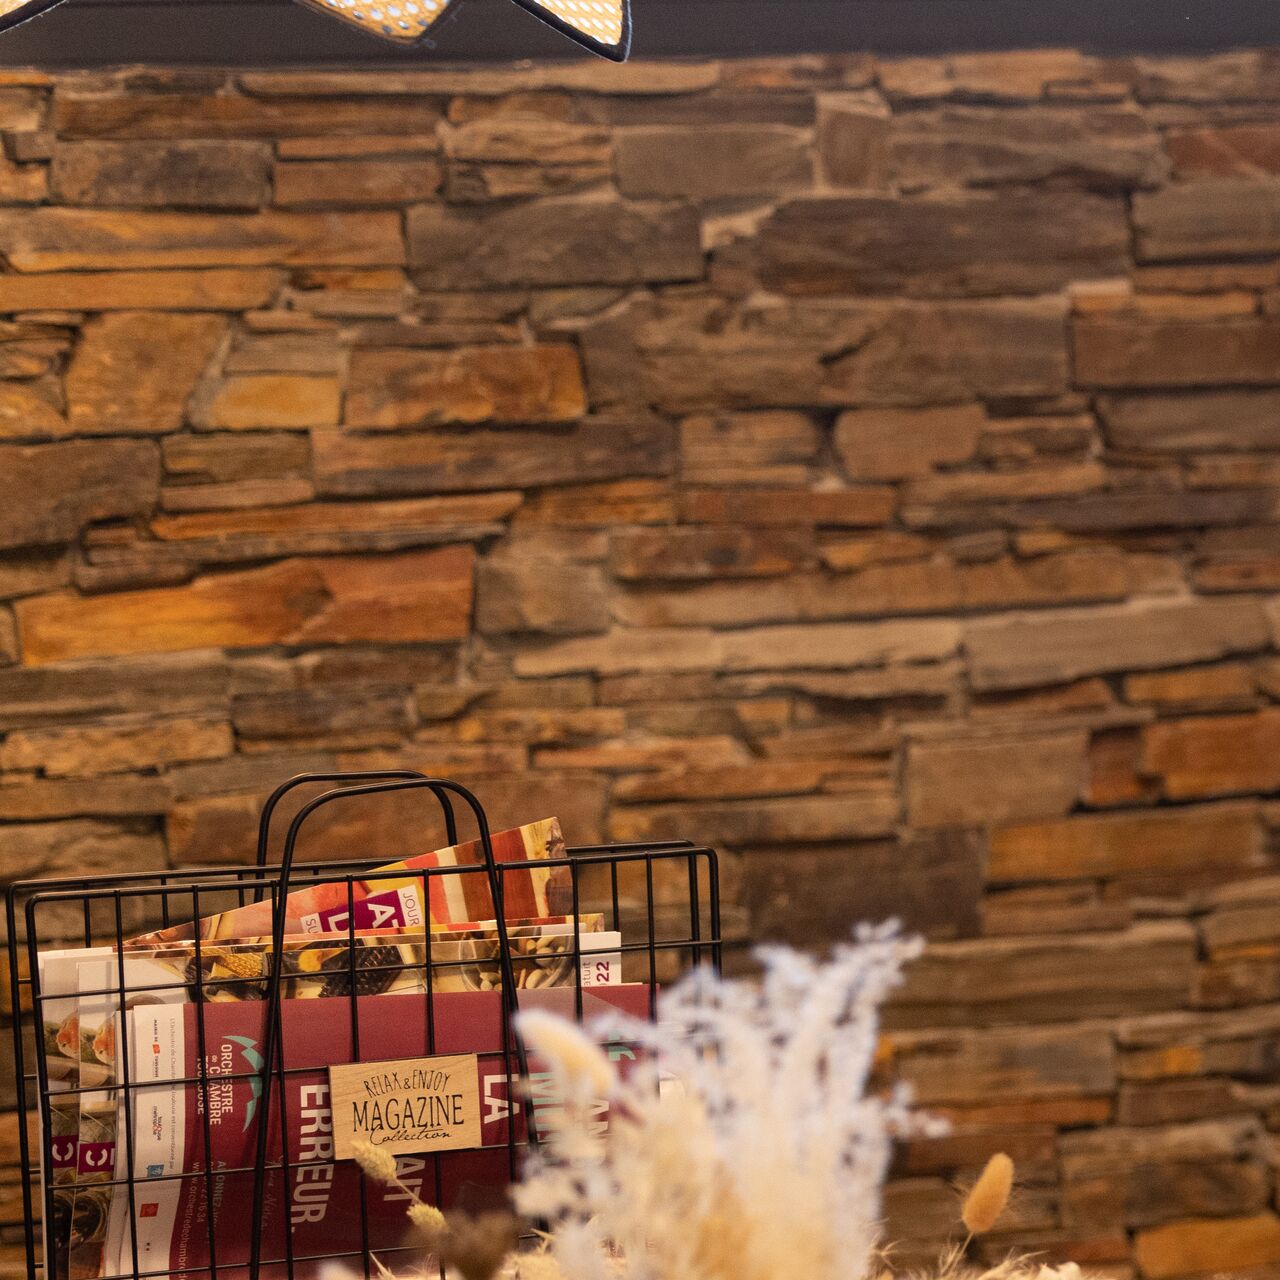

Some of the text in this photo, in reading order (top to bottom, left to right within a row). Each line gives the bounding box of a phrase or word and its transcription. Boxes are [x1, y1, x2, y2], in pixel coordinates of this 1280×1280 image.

[197, 1056, 208, 1115] TOUOUSE
[363, 1072, 402, 1099] RELAX
[412, 1069, 452, 1093] ENJOY
[483, 1074, 520, 1125] LA
[352, 1094, 465, 1132] MAGAZINE
[369, 1124, 453, 1146] Collection
